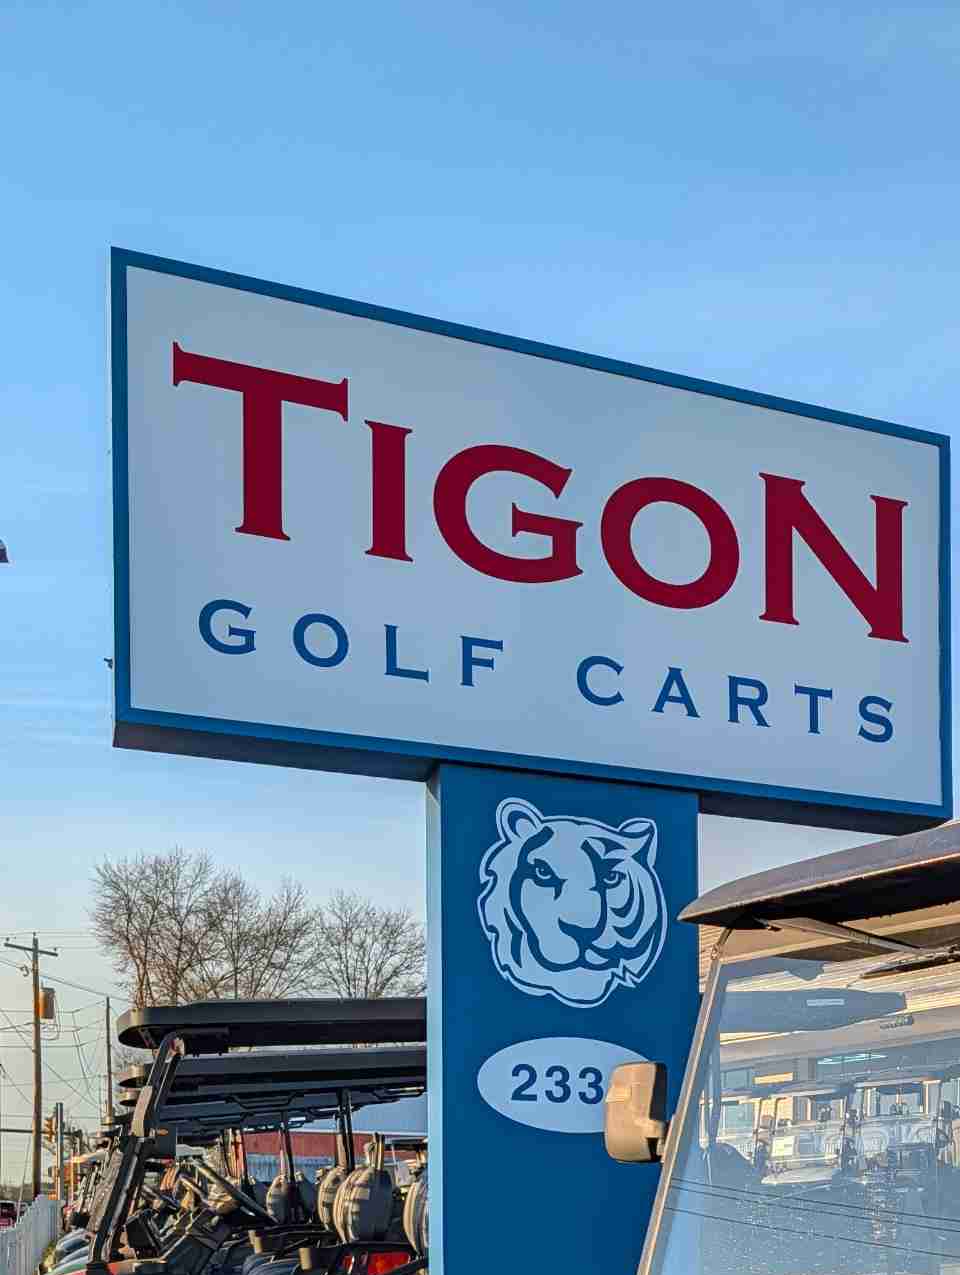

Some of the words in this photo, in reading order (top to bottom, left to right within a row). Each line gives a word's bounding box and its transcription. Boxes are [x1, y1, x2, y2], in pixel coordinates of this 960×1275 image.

[173, 341, 909, 643] TIGON
[199, 599, 504, 688] GOLF
[576, 655, 894, 743] CARTS
[511, 1063, 604, 1105] 233
